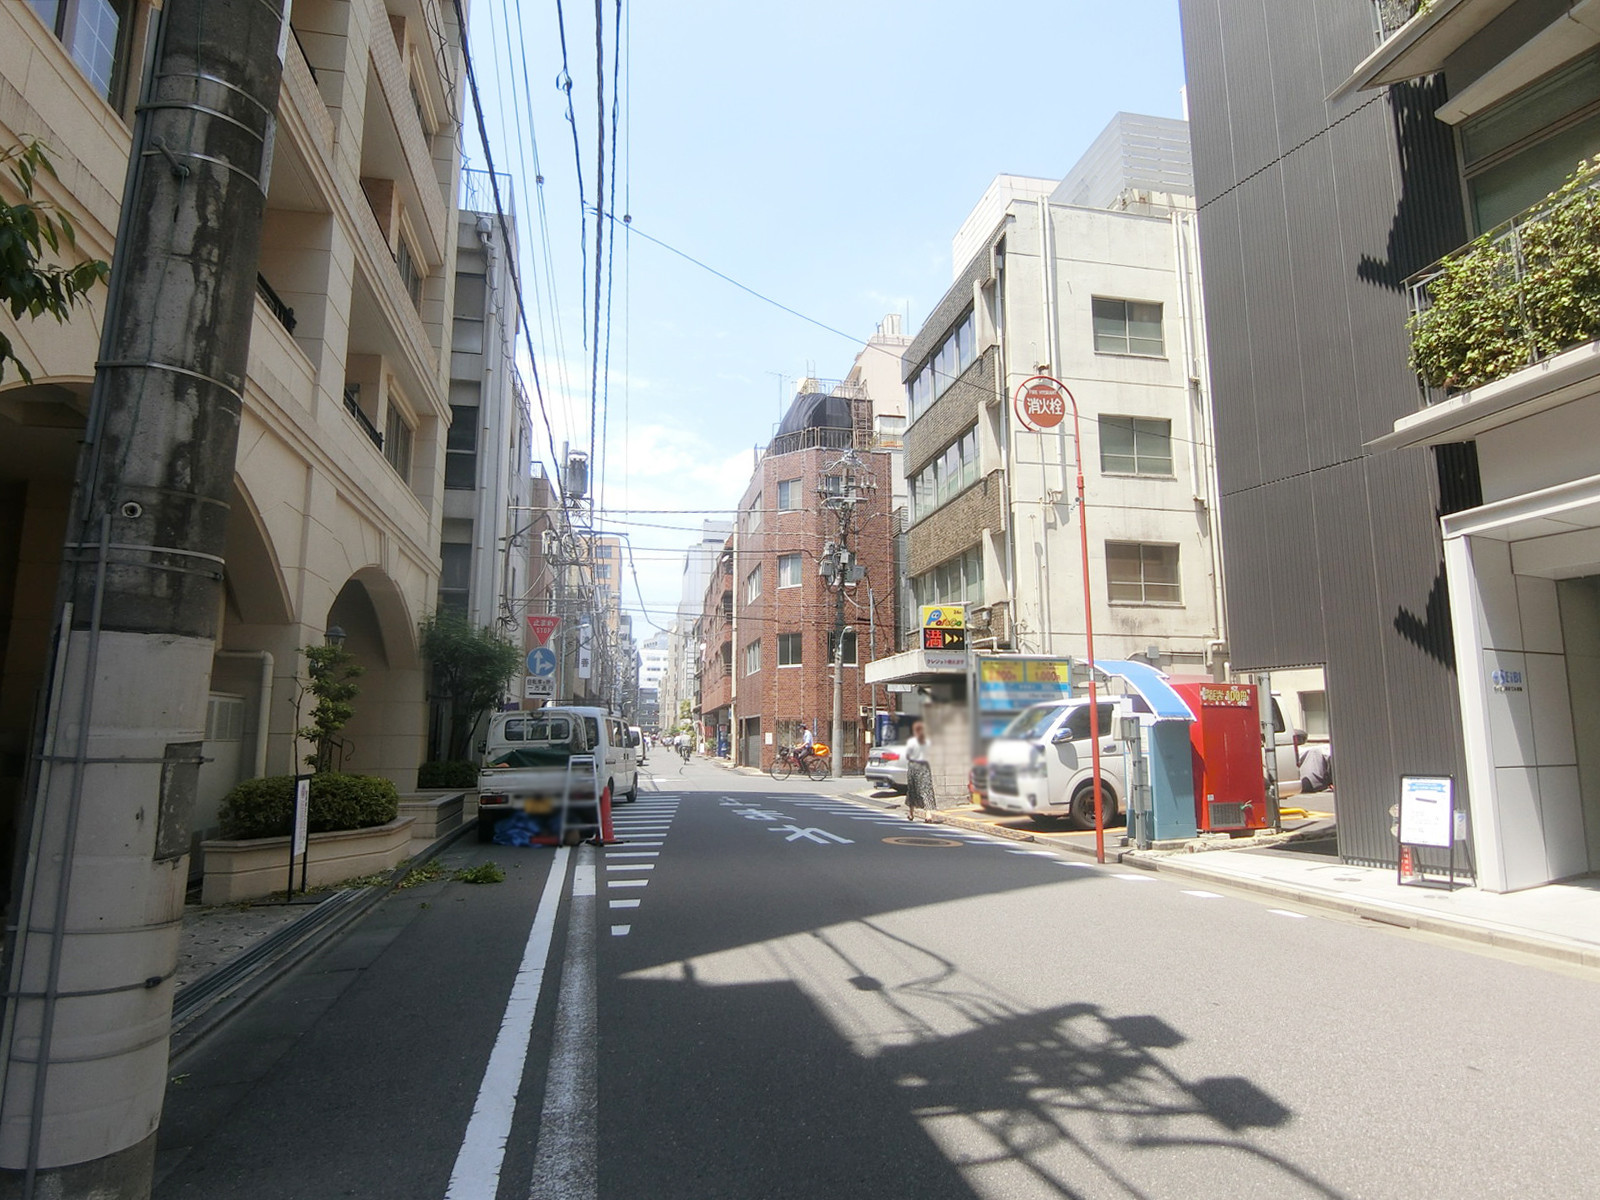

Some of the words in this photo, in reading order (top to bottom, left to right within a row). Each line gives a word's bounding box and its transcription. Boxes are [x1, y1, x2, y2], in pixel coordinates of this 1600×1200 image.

[1027, 397, 1063, 415] 消火栓
[925, 630, 944, 648] 満
[718, 796, 856, 844] 止まれ
